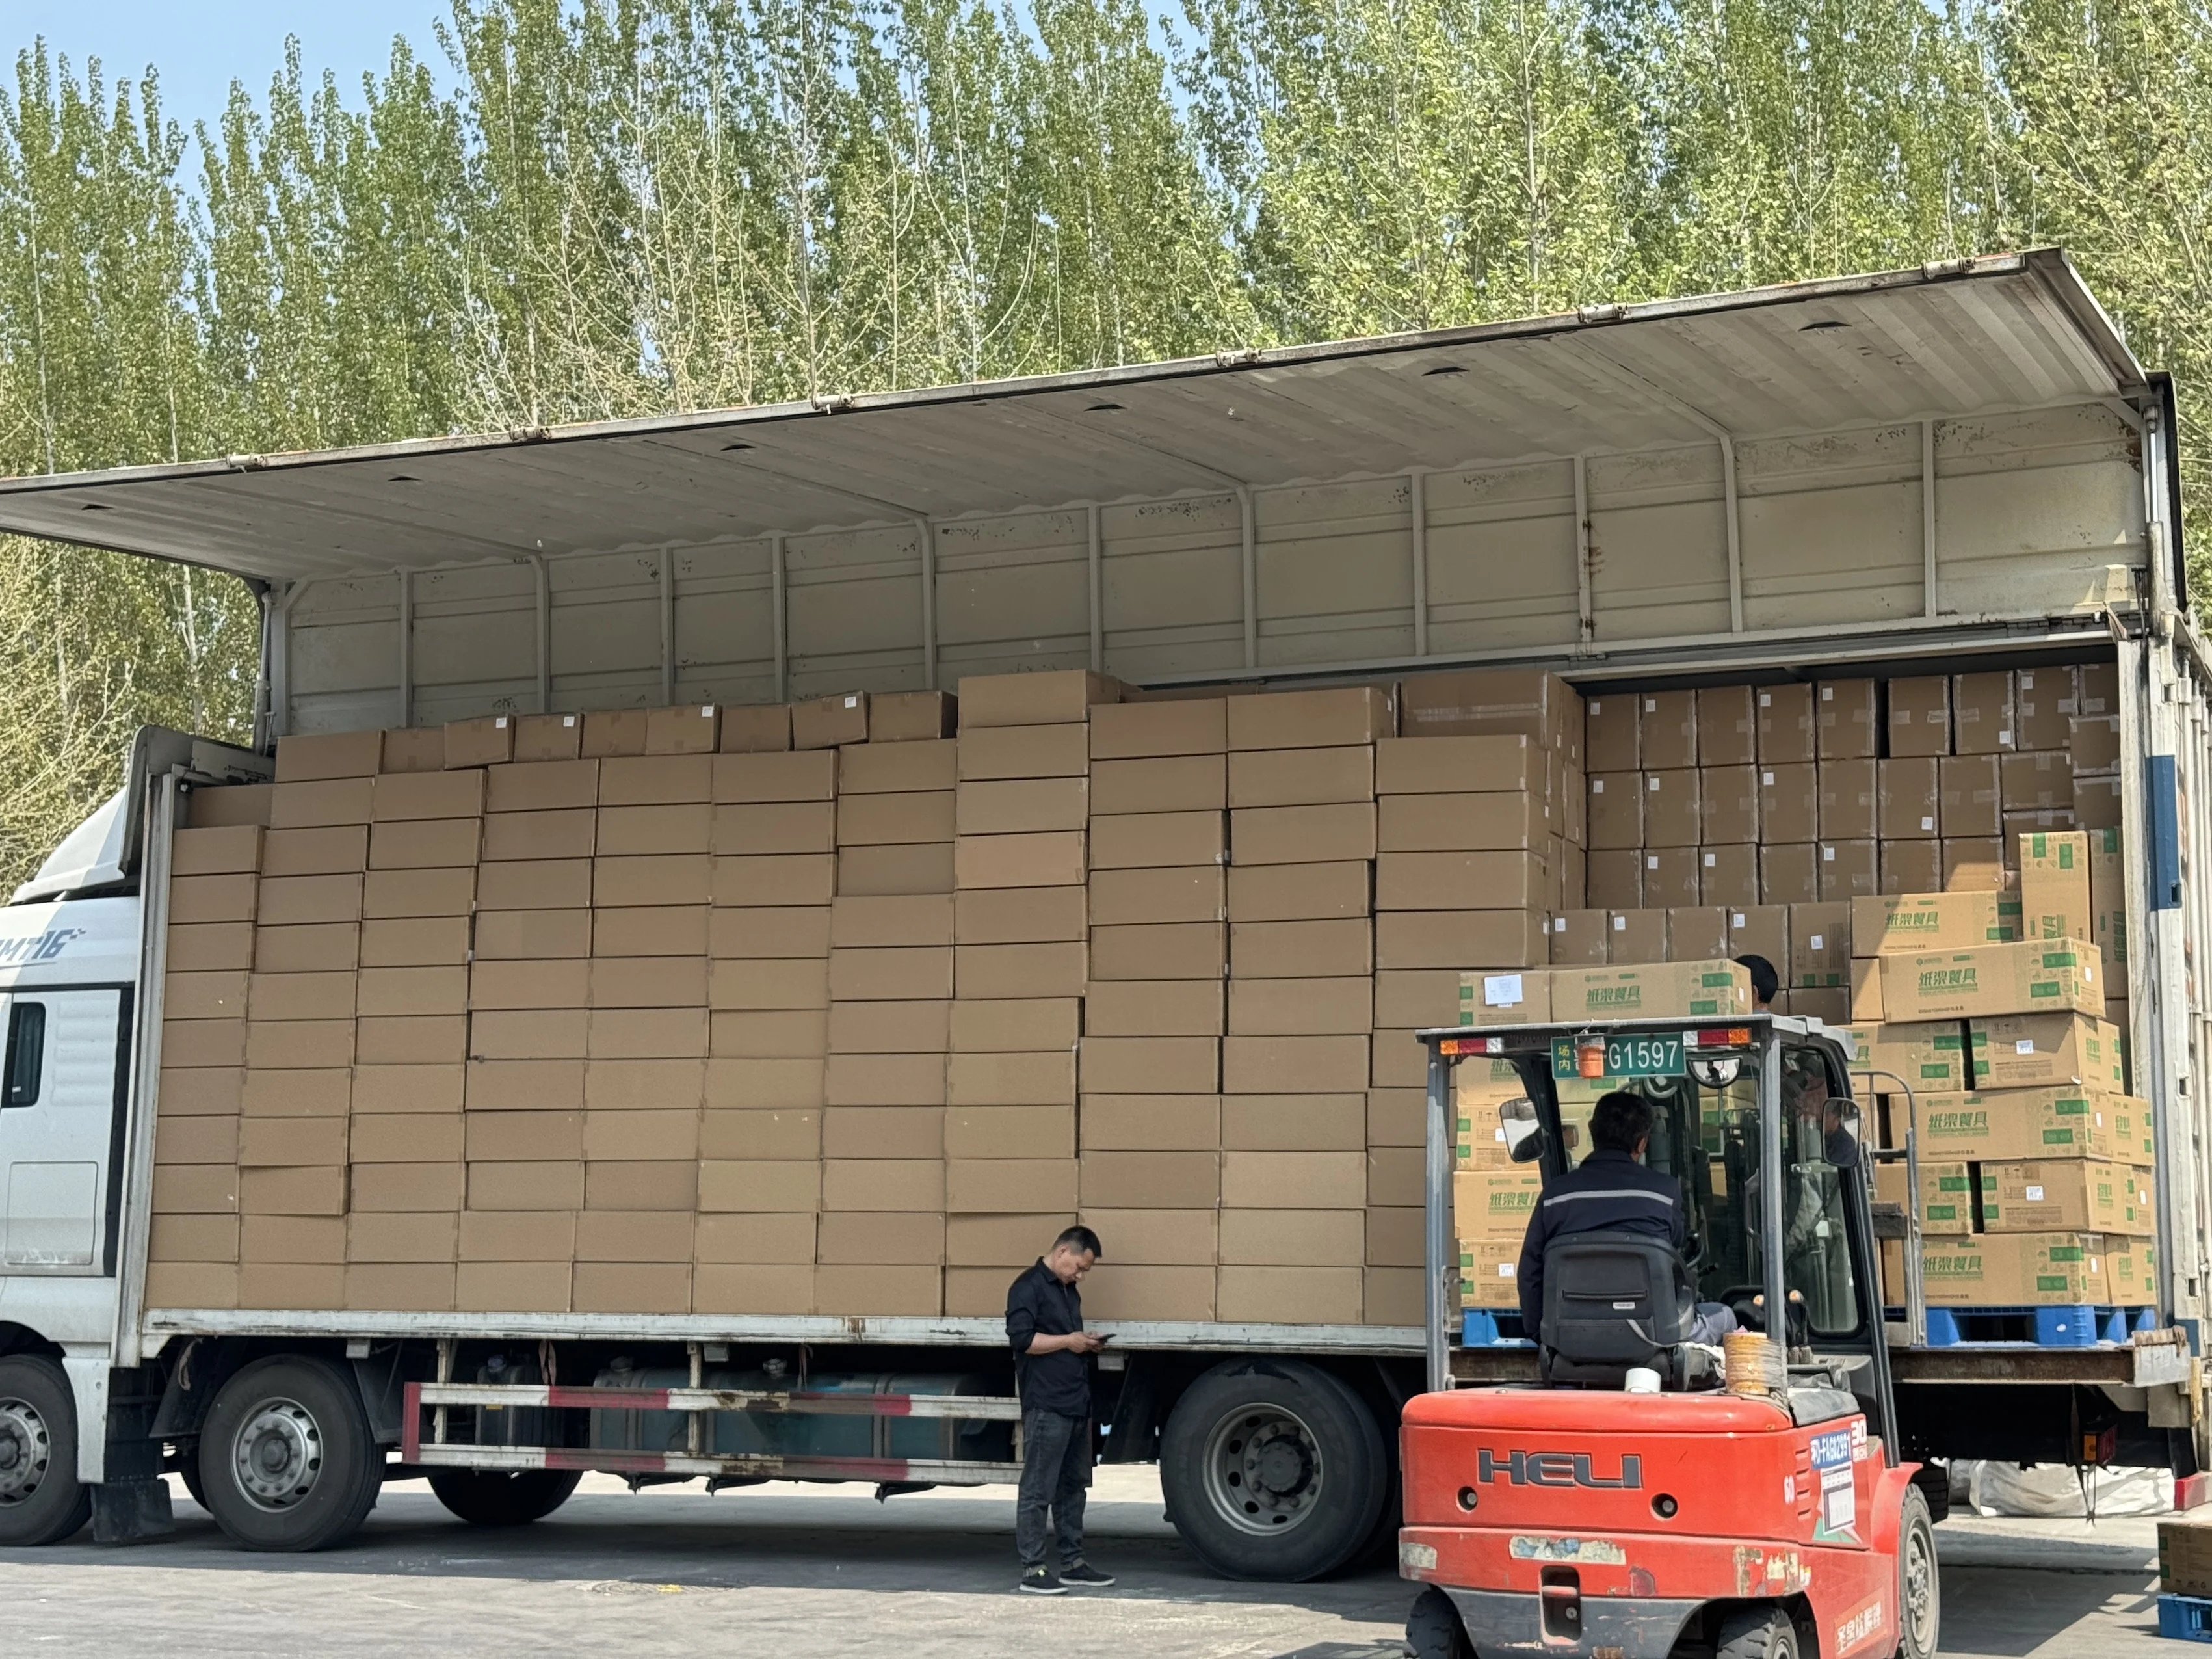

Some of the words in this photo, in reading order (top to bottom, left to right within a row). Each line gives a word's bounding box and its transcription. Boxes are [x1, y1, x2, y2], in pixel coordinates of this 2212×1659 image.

[1886, 912, 1938, 926] 纸浆餐具
[0, 929, 75, 961] MT16
[1919, 968, 1976, 986] 纸浆餐具
[1587, 985, 1641, 1002] 纸浆餐具
[1573, 1041, 1678, 1070] -G1597
[1928, 1111, 1988, 1129] 纸浆餐具
[1923, 1255, 1982, 1272] 纸浆餐具
[1850, 1420, 1867, 1446] 30
[1477, 1449, 1643, 1489] HELI
